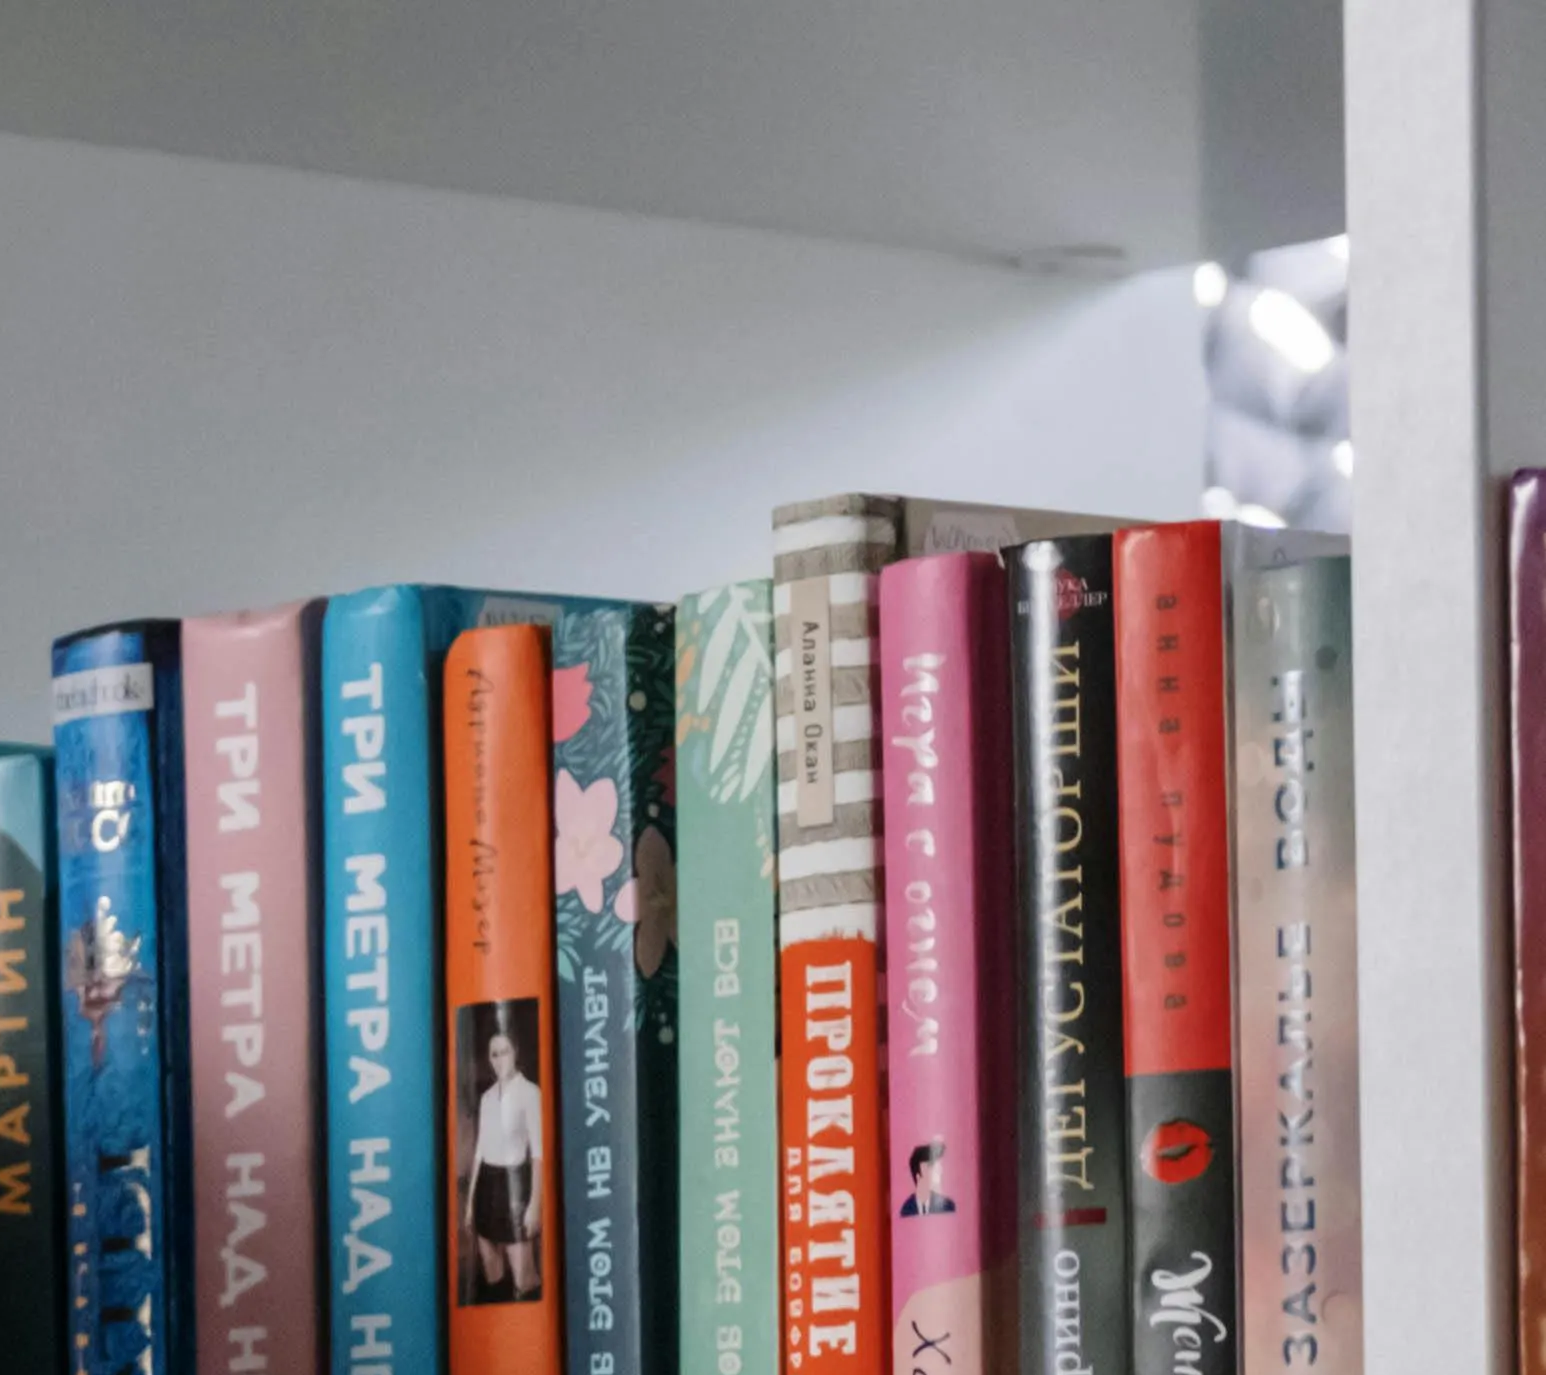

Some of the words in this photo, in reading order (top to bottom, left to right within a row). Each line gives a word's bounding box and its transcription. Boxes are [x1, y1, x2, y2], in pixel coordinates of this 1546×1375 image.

[340, 661, 387, 816] ТРИ
[800, 620, 819, 713] Аланна
[892, 651, 948, 809] Игра
[214, 681, 261, 833] ТРИ
[802, 722, 824, 785] Окан
[1271, 669, 1317, 871] ВОДЫ
[905, 827, 936, 858] с
[1045, 638, 1094, 1191] ДЕГУСТАТОРШИ
[218, 870, 267, 1120] МЕТРА
[344, 852, 392, 1105] МЕТРА
[902, 880, 941, 1058] огнем
[713, 1018, 742, 1169] ЗНАЮТ
[805, 960, 860, 1358] ПРОКЛЯТИЕ
[1277, 920, 1320, 1368] ЗАЗЕРКАЛЬЕ
[220, 1151, 269, 1310] НАД
[342, 1137, 393, 1295] НАД
[713, 1189, 743, 1304] ЭТОМ
[787, 1146, 803, 1223] ДЛЯ
[587, 1215, 614, 1331] ЭТОМ
